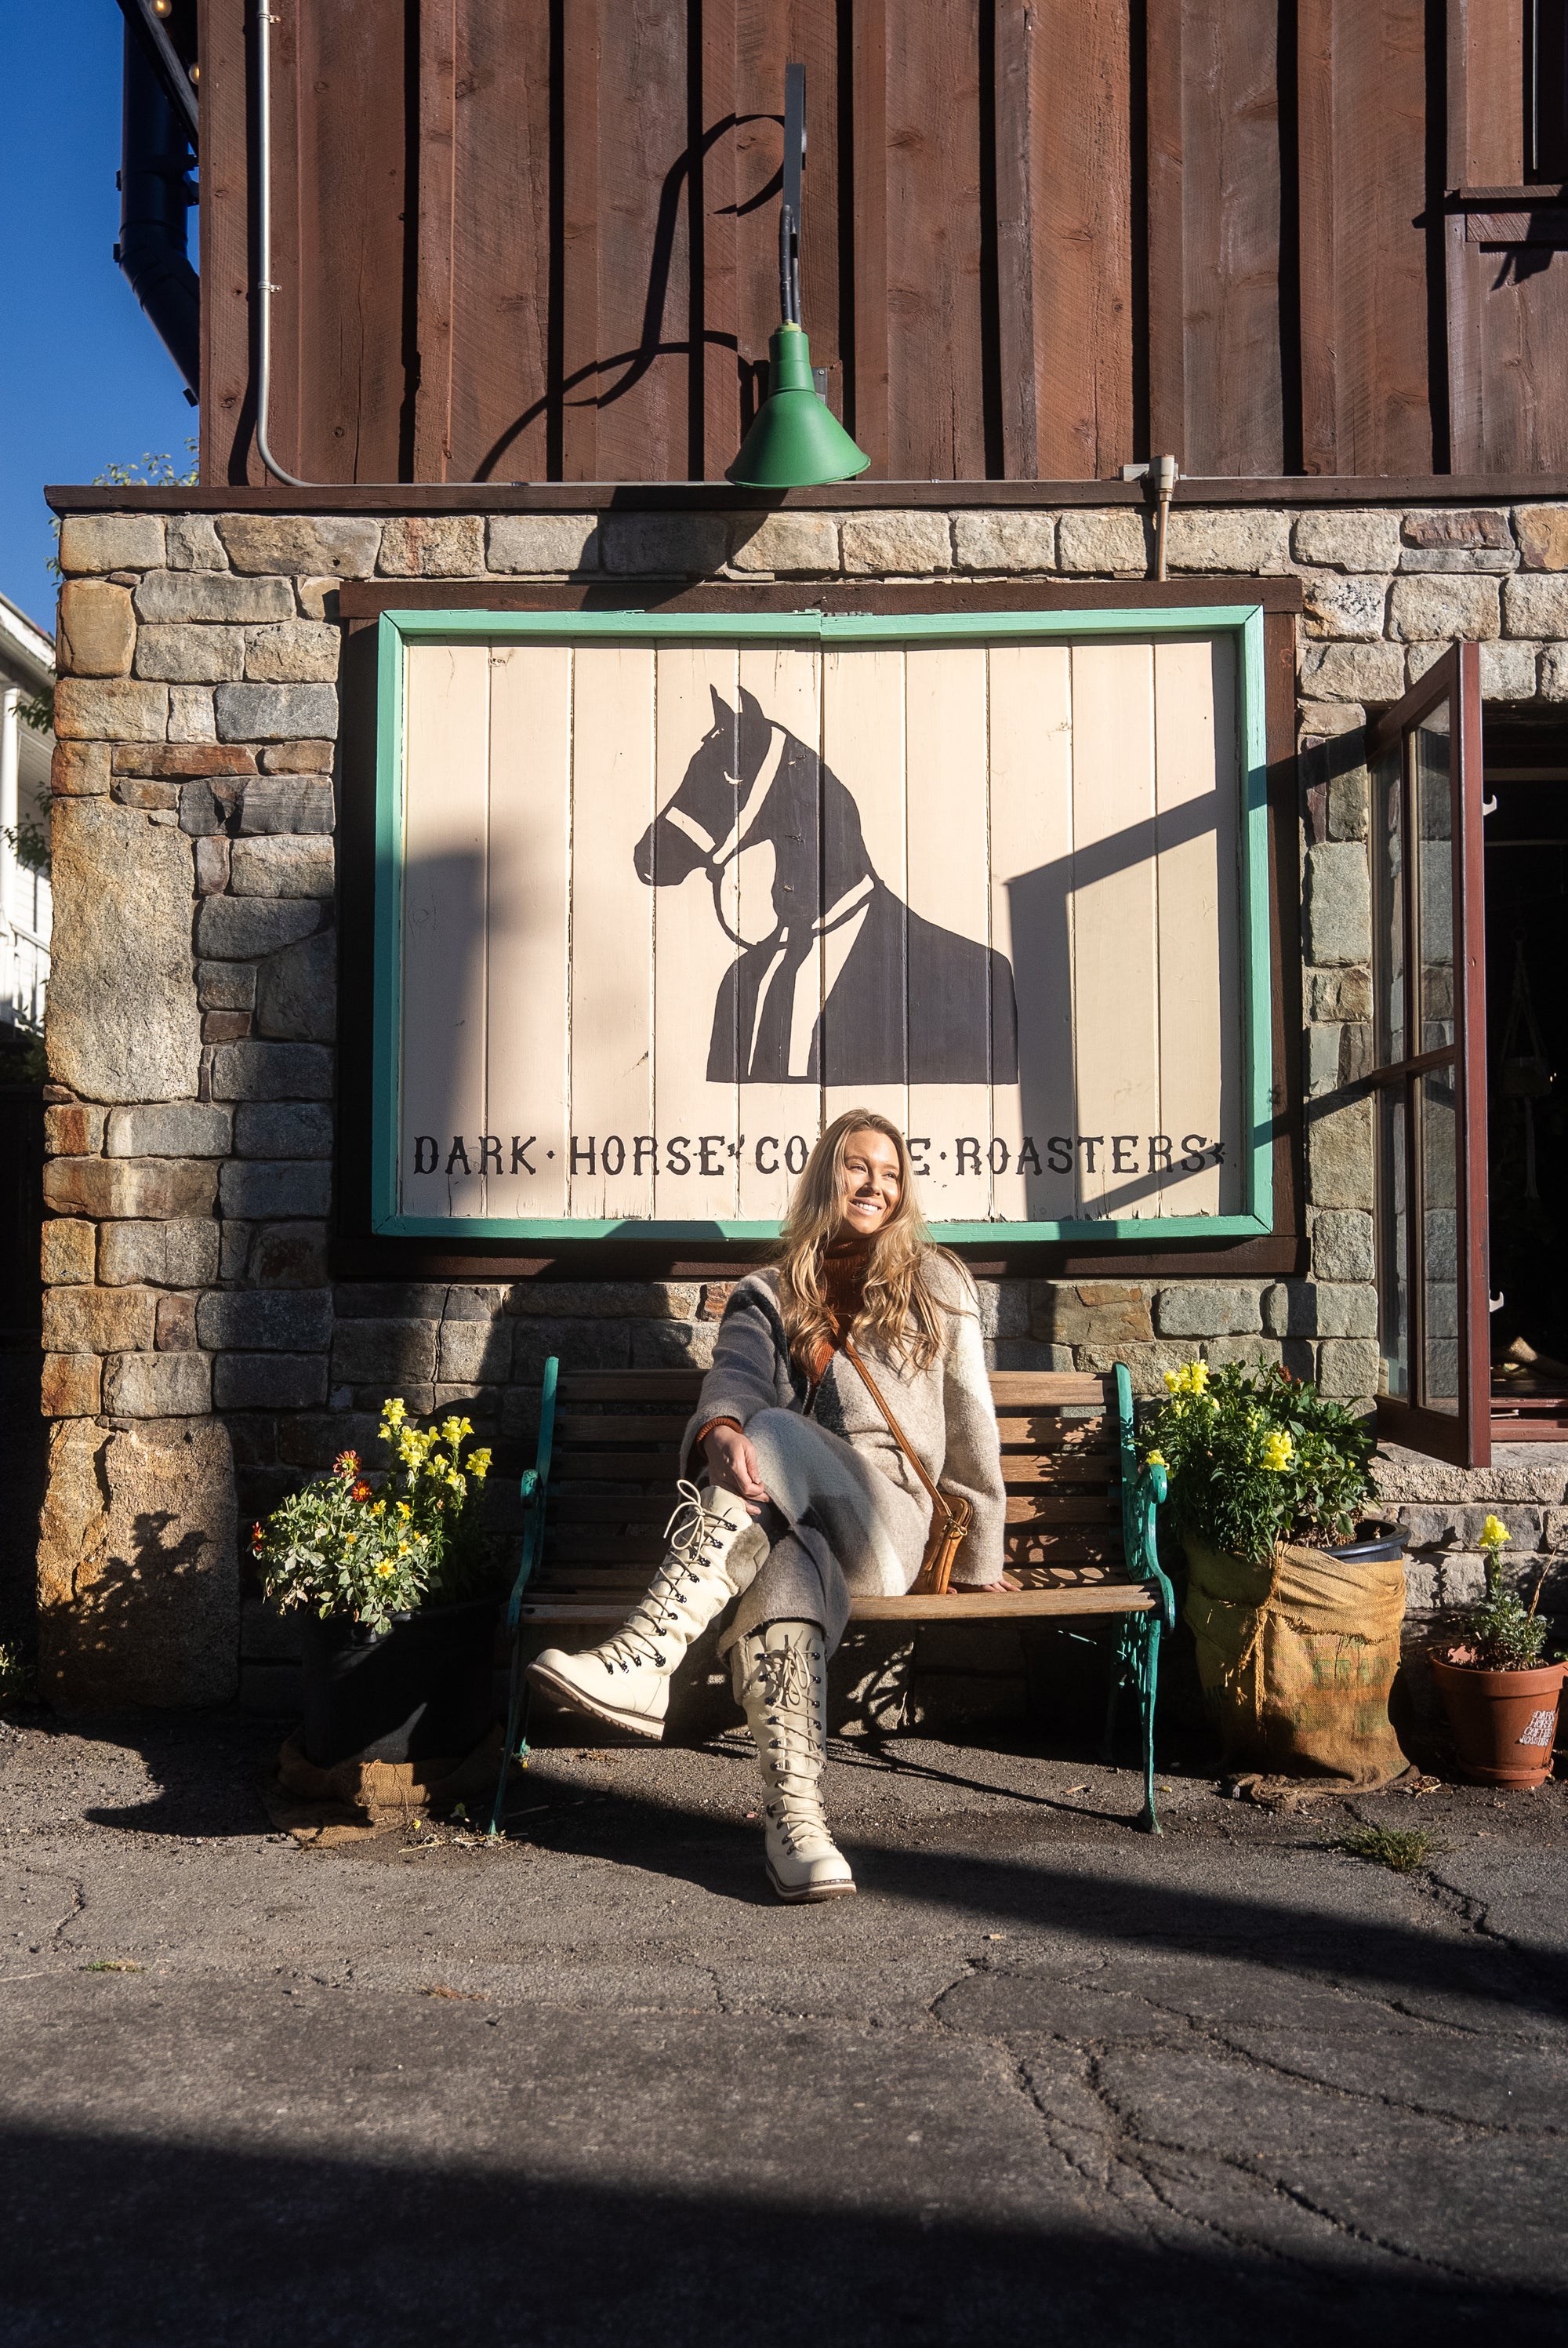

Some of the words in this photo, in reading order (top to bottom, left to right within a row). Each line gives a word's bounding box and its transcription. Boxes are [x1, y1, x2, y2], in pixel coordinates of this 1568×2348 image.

[413, 1136, 536, 1176] DARK
[570, 1135, 726, 1176] HORSE
[755, 1135, 931, 1176] COE
[955, 1134, 1209, 1176] ROASTERS
[1533, 1710, 1555, 1720] DARK
